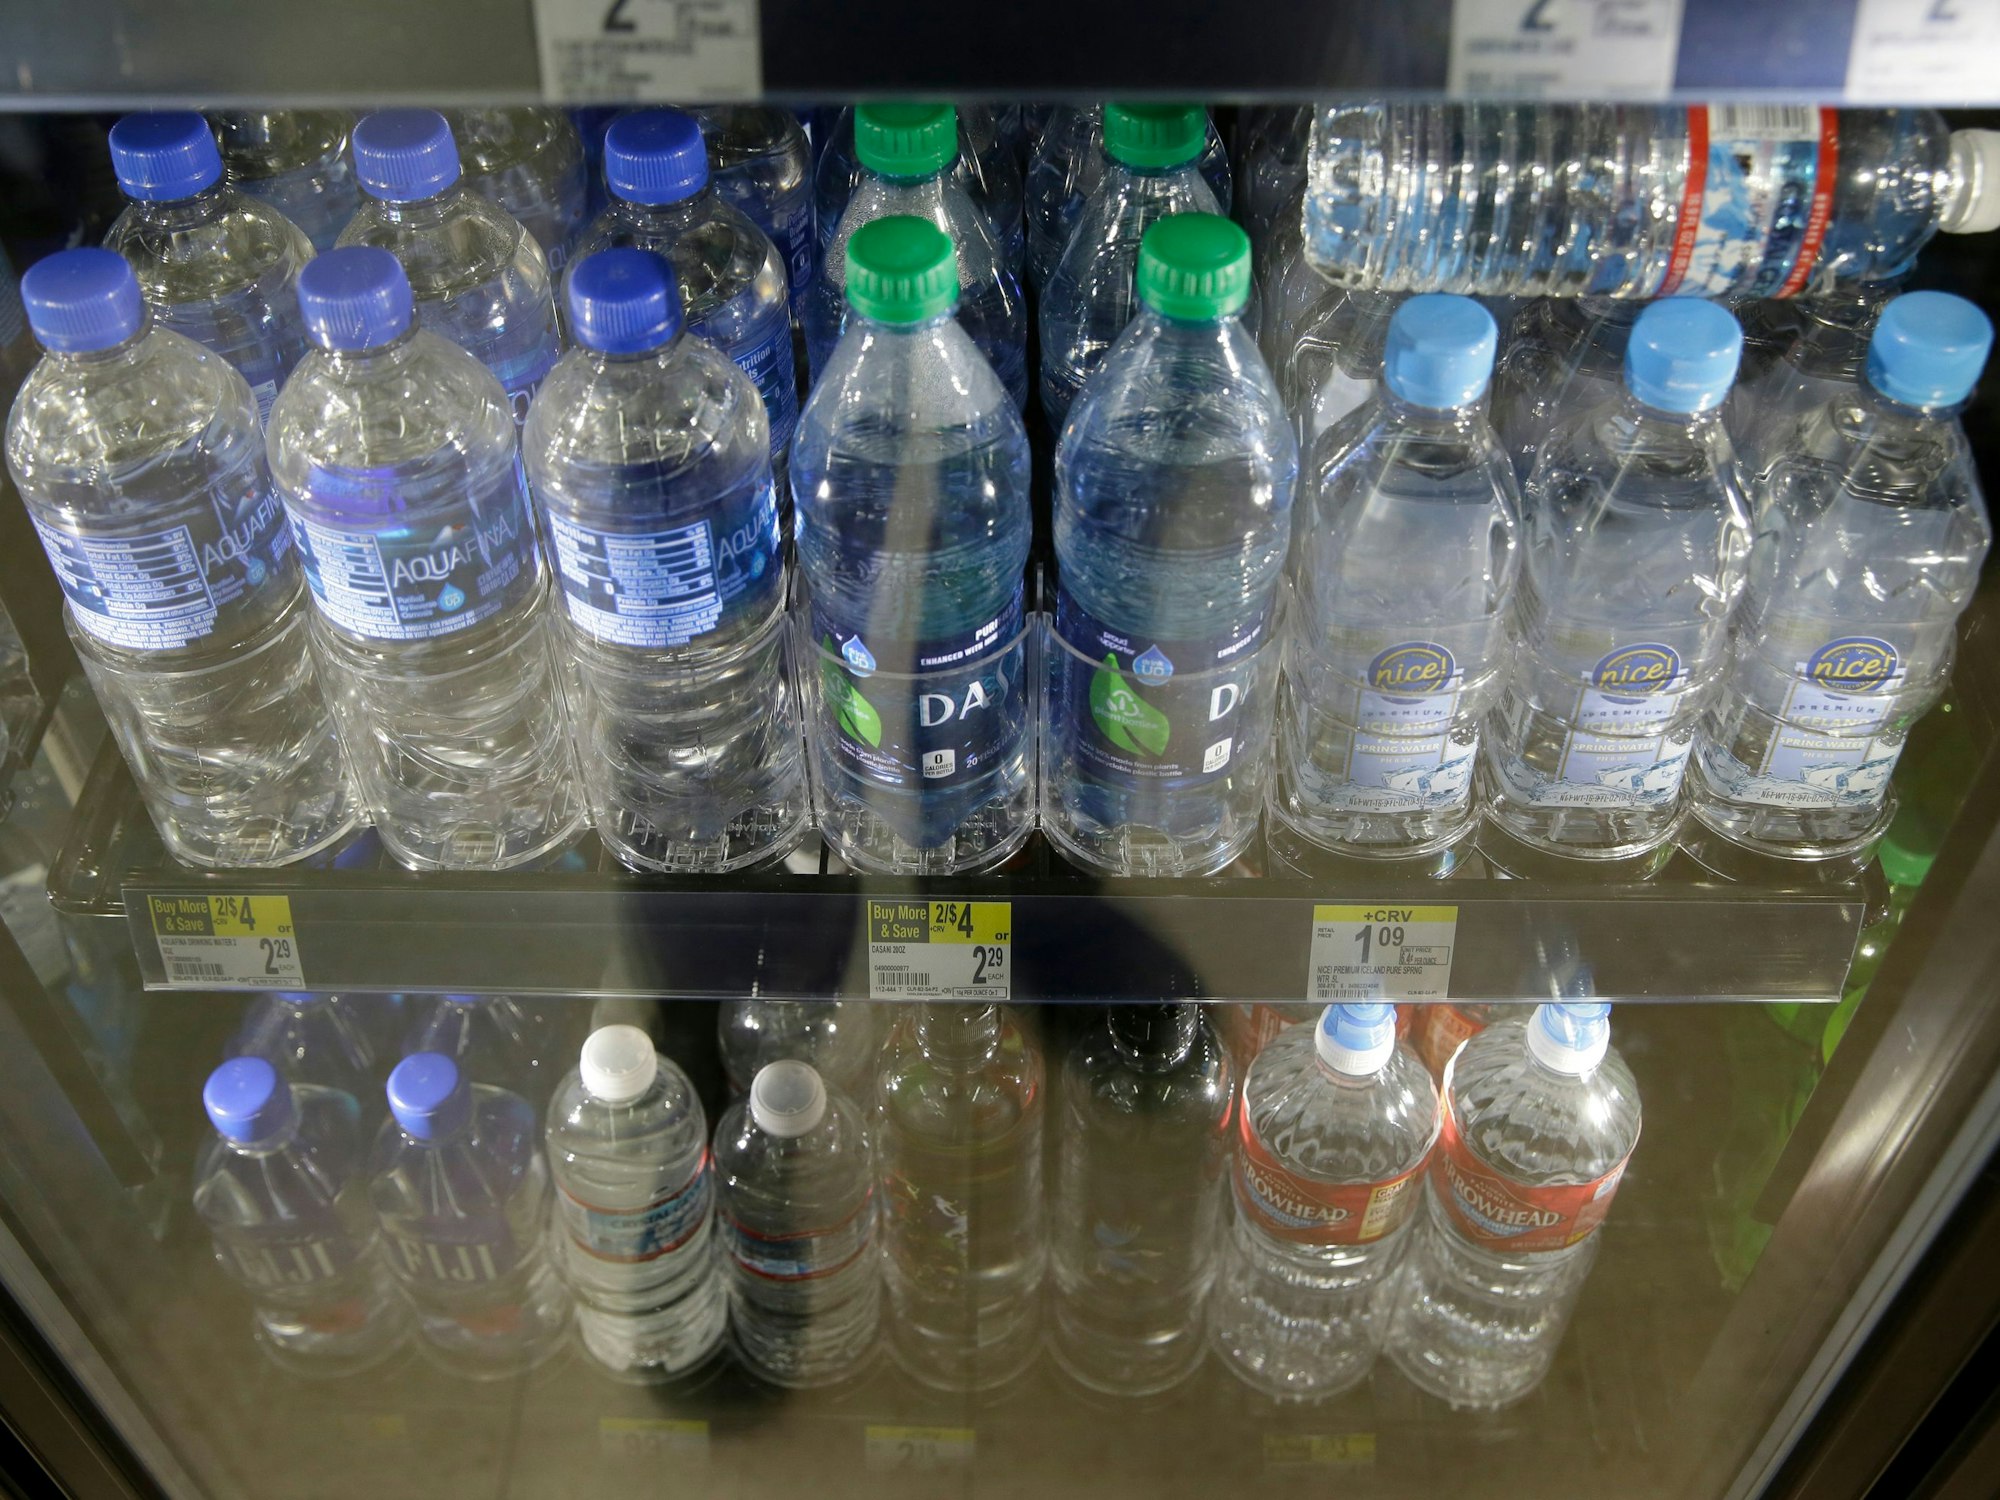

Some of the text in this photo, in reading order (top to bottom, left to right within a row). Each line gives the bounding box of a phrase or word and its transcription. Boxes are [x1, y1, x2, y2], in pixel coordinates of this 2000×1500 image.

[739, 346, 771, 371] trition
[393, 513, 516, 588] AQUAFNA
[1374, 656, 1447, 687] nice!
[1599, 656, 1673, 688] nice!
[1814, 654, 1891, 677] nice!
[1354, 742, 1441, 753] SPRING WATER
[1573, 741, 1657, 752] SPRING WATER
[1780, 737, 1866, 749] SPRING WATER
[1214, 745, 1223, 757] 0
[934, 753, 944, 765] 0
[154, 899, 177, 916] Buy
[179, 899, 209, 914] More
[873, 905, 894, 923] Buy
[898, 905, 927, 920] More
[1364, 910, 1413, 923] +CRV
[165, 917, 205, 932] & Save
[278, 925, 292, 933] or
[881, 923, 920, 938] & Save
[995, 932, 1009, 941] or
[1333, 966, 1360, 975] PREMIUM
[1361, 966, 1385, 975] ICELAND
[1386, 966, 1401, 975] PURE
